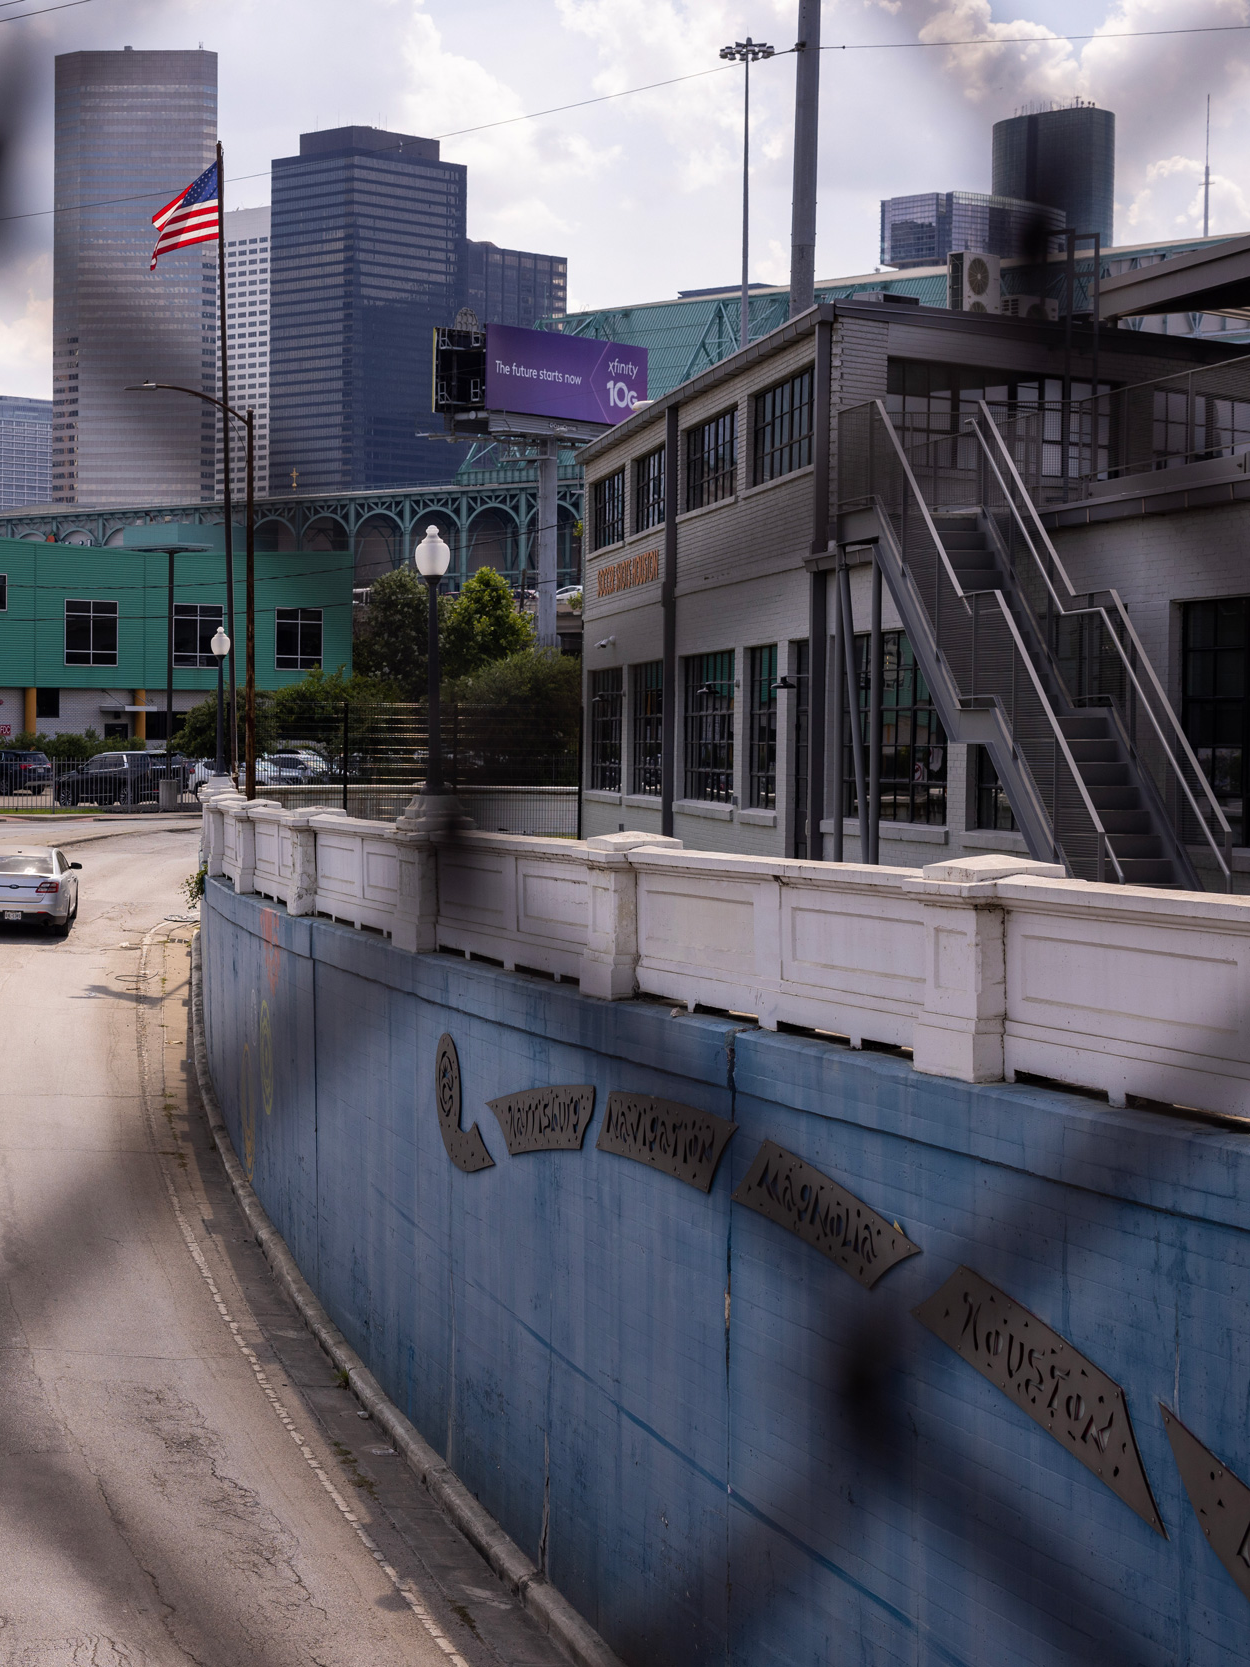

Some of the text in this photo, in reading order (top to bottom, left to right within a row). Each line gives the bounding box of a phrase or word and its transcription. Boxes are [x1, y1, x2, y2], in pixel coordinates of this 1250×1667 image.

[495, 360, 582, 385] The future starts now
[608, 358, 639, 379] xfinity
[606, 380, 638, 409] 10G
[632, 549, 659, 586] HOUSTON
[0, 725, 11, 734] FDC
